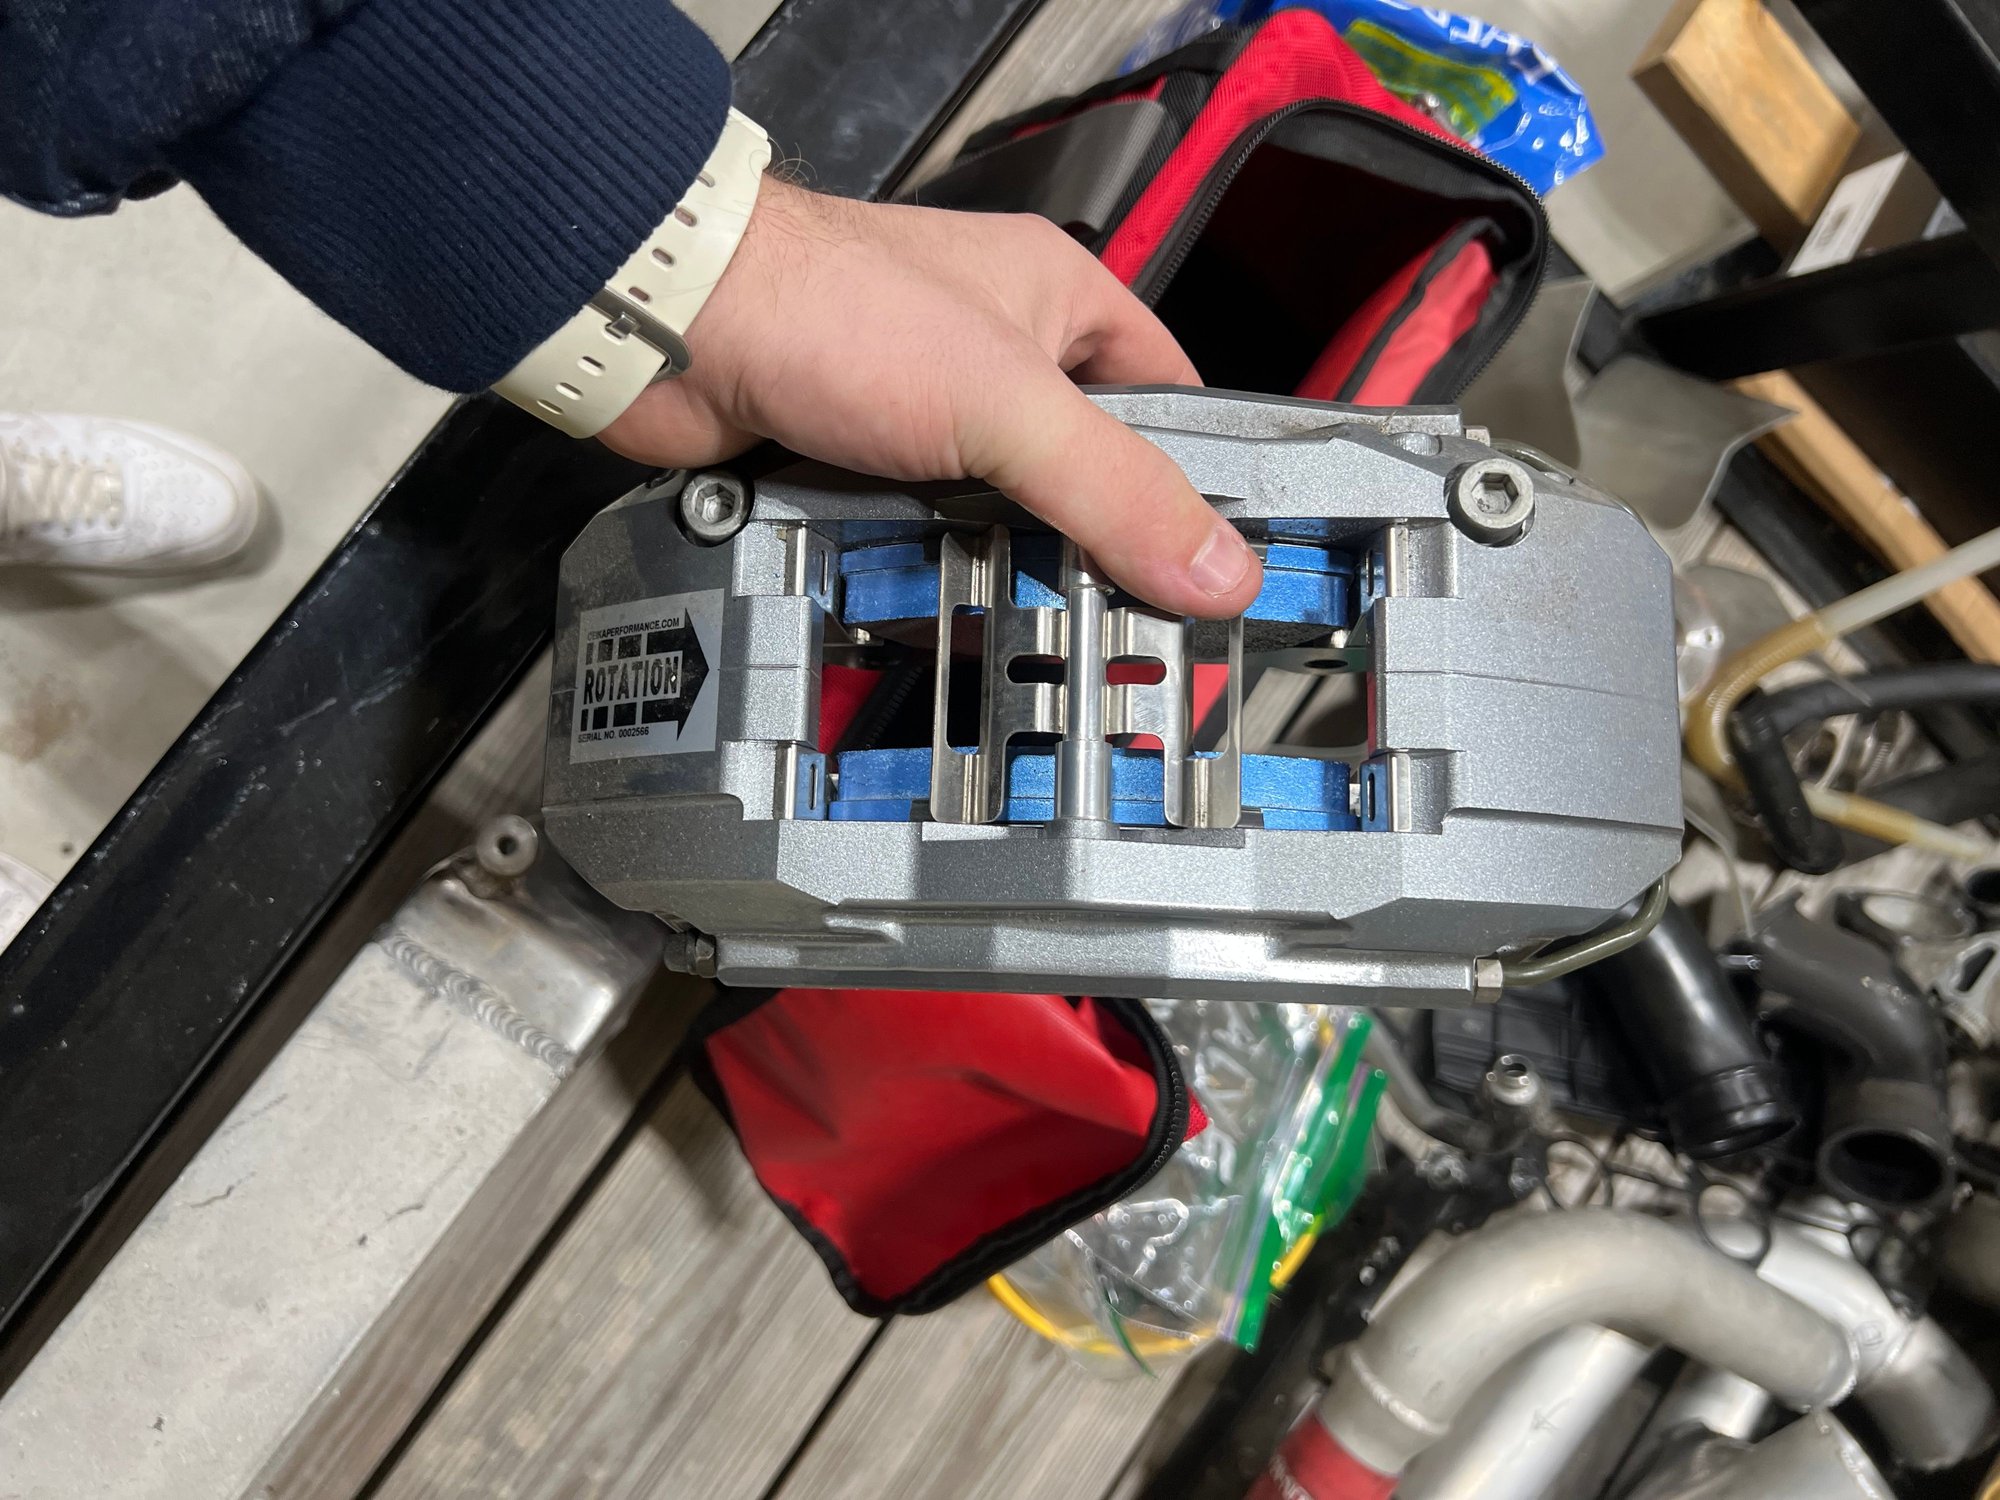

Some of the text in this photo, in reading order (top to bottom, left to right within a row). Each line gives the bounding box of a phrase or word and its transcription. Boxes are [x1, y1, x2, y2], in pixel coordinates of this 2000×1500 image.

[584, 656, 679, 705] ROTATION
[578, 732, 602, 743] SERIAL
[604, 730, 616, 739] NO.
